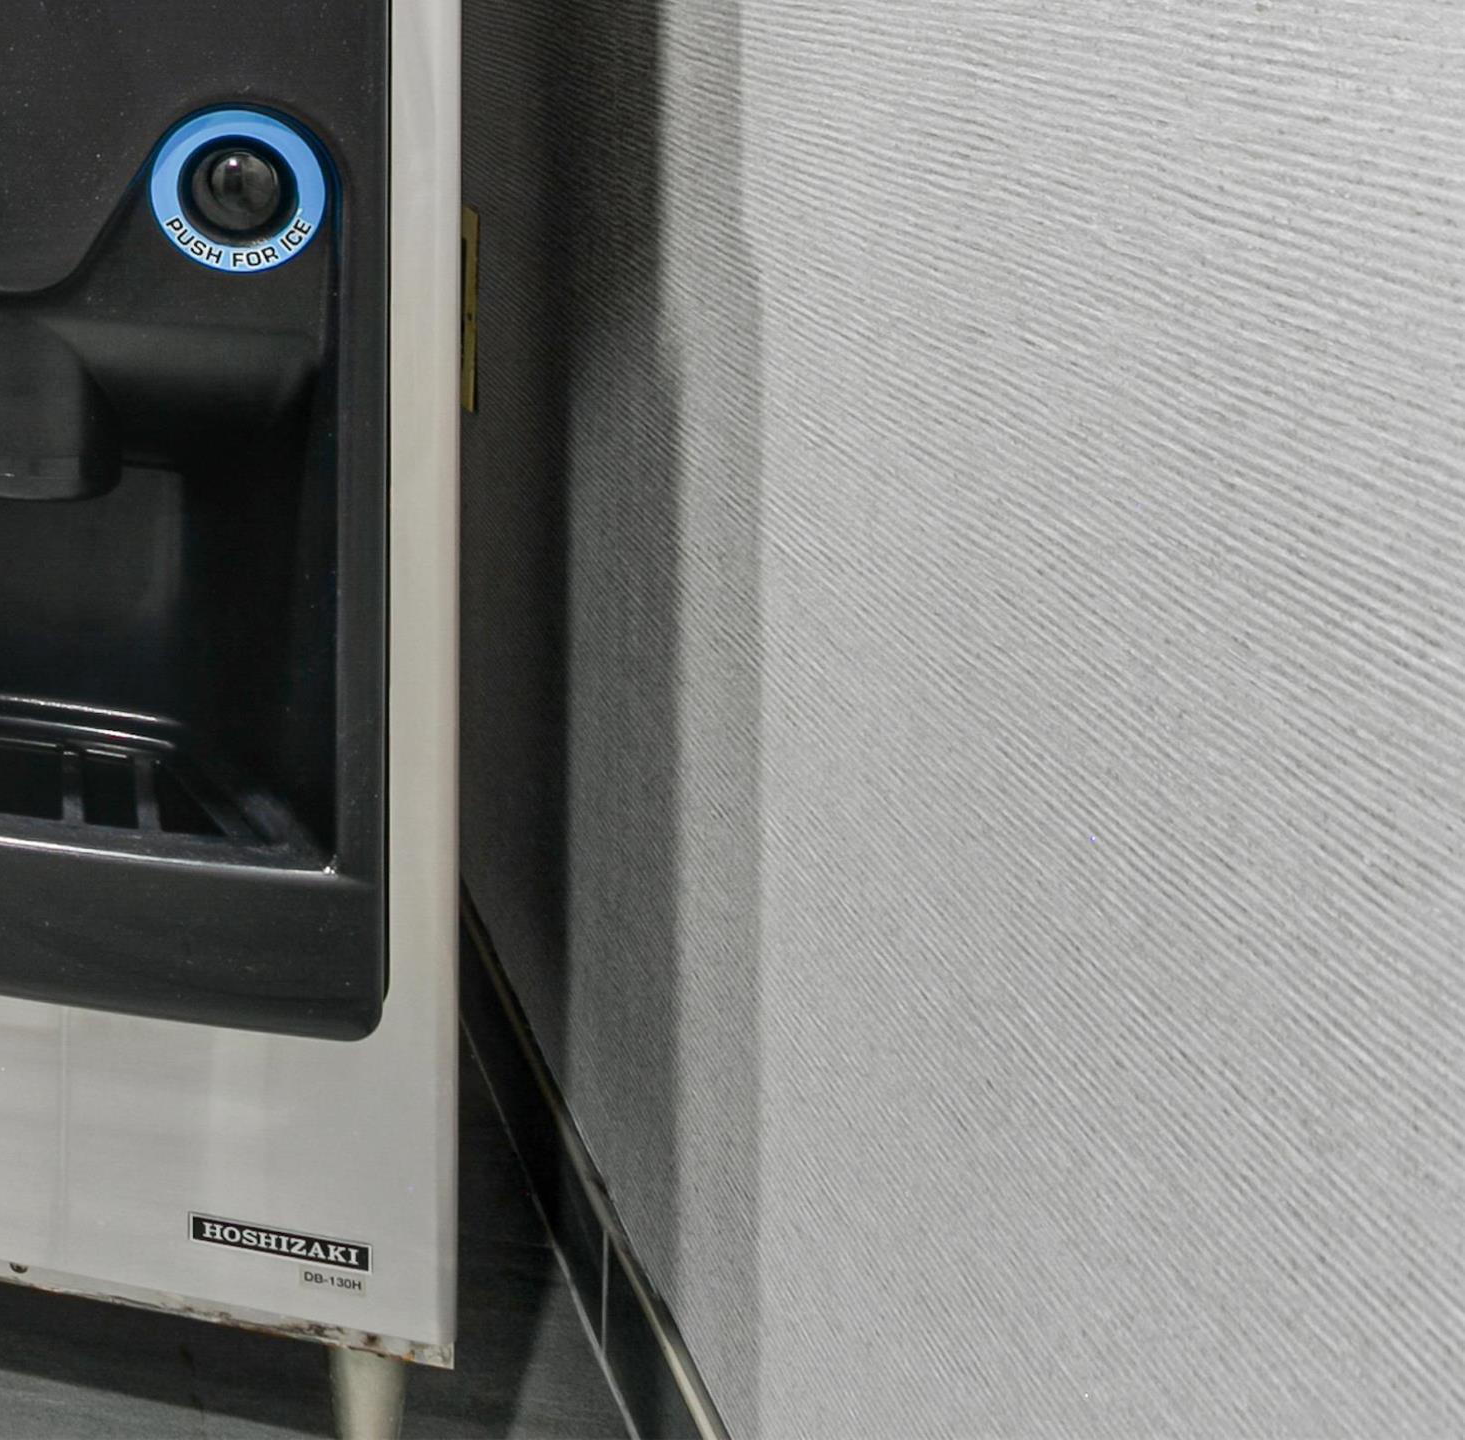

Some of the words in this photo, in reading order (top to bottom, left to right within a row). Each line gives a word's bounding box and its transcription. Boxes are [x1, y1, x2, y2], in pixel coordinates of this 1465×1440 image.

[166, 217, 223, 264] PUSH
[232, 246, 279, 267] FOR
[280, 219, 312, 251] ICE
[202, 1221, 359, 1266] HOSHIZAKI
[303, 1271, 362, 1291] DB-130H
